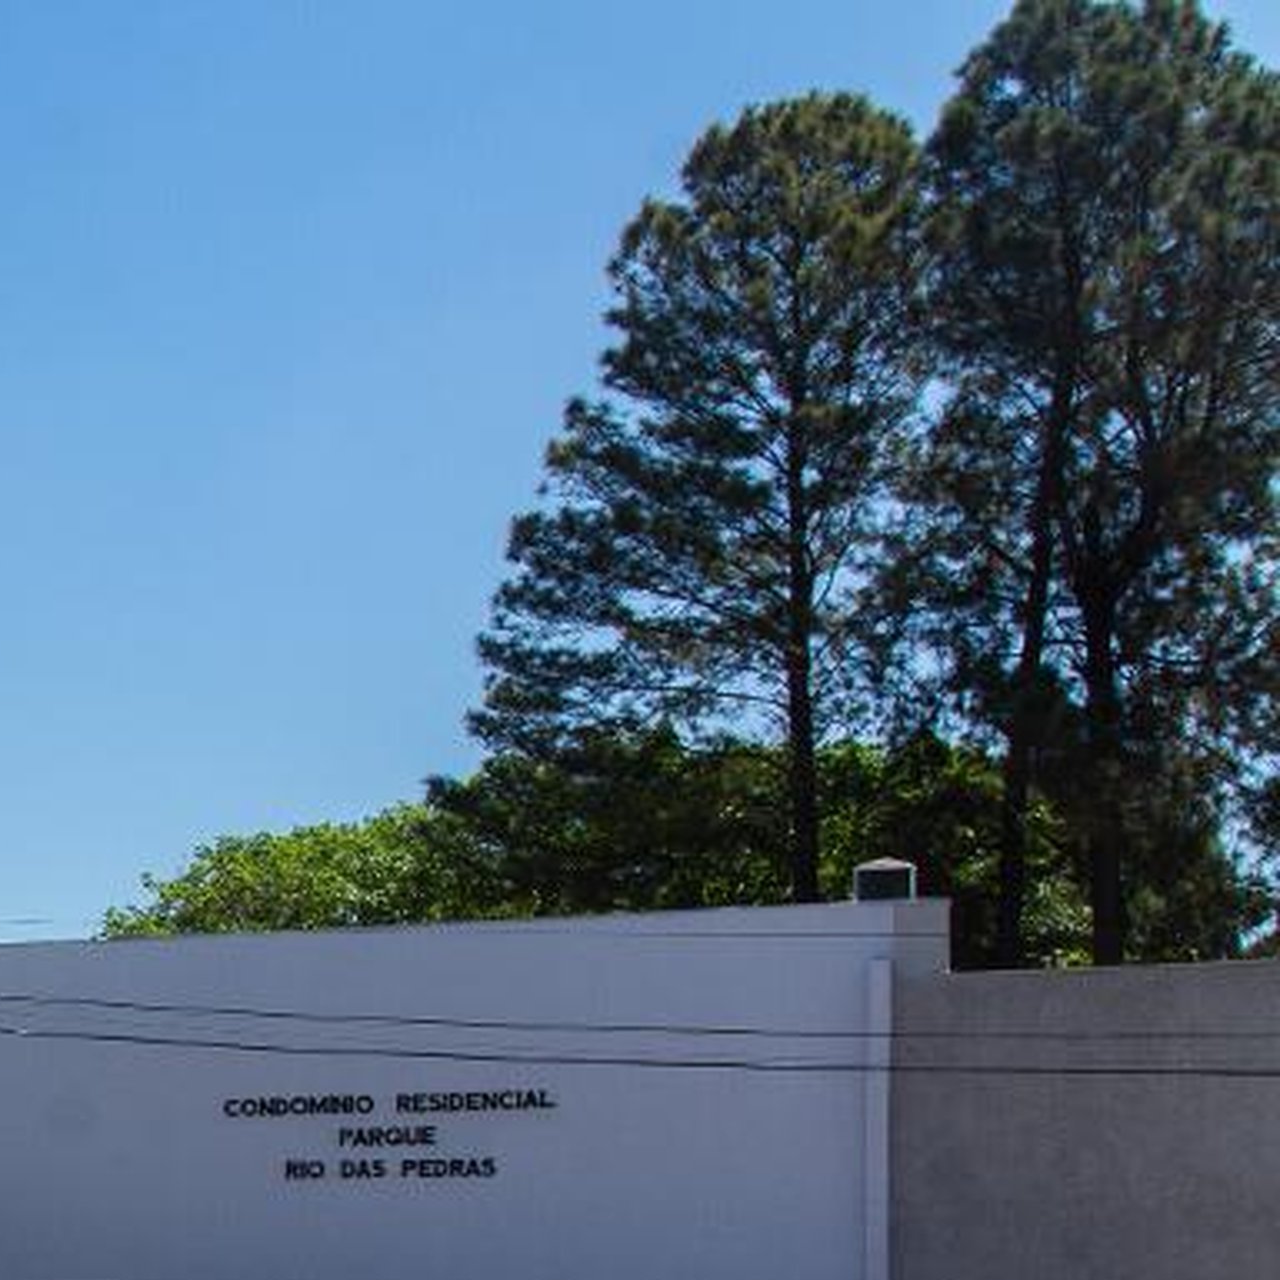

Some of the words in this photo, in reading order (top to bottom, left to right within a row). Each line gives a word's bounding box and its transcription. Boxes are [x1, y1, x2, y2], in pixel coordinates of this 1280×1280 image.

[223, 1094, 375, 1117] CONDOMINIO
[396, 1090, 557, 1113] RESIDENCIAL
[339, 1126, 437, 1147] PARQUE
[285, 1159, 325, 1180] RIO
[341, 1159, 386, 1179] DAS
[401, 1157, 496, 1178] PEDRAS
